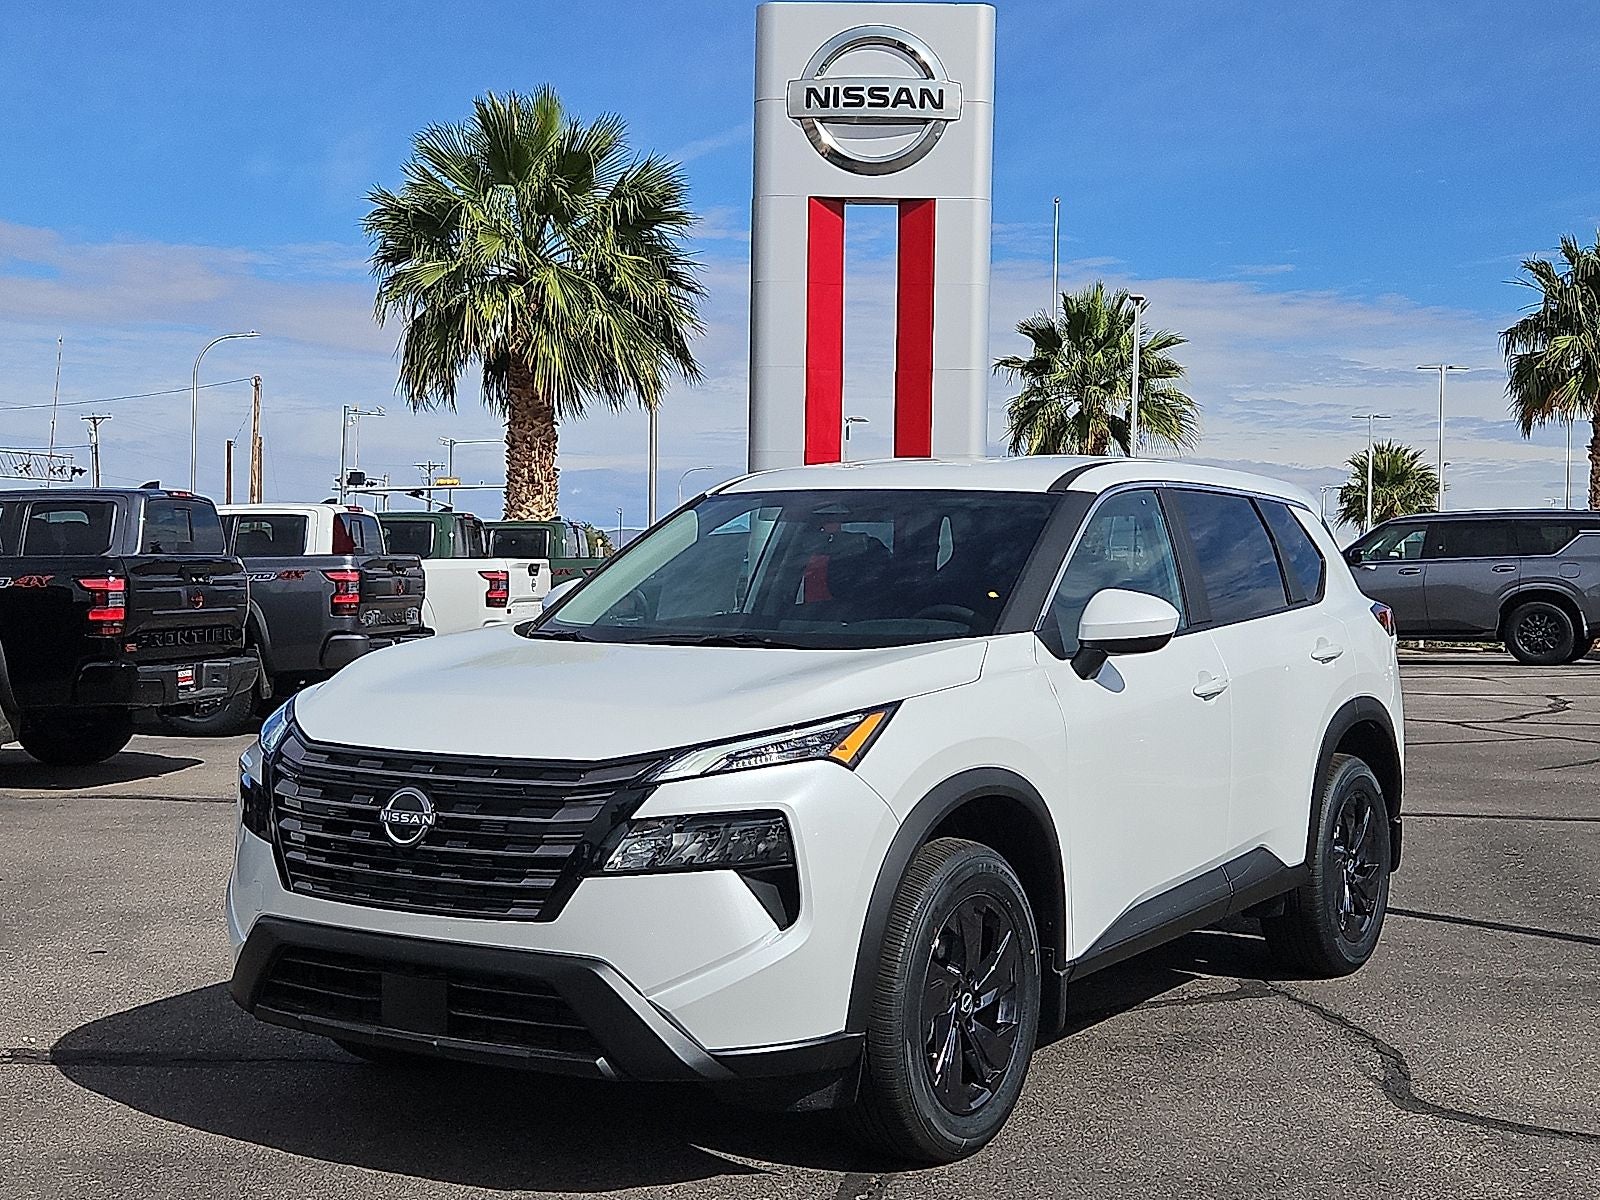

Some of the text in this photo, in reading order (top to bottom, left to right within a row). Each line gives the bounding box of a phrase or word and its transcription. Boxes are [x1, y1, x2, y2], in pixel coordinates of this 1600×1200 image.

[805, 86, 944, 110] NISSAN
[137, 626, 234, 648] FRONTIER
[380, 809, 432, 825] NISSAN
